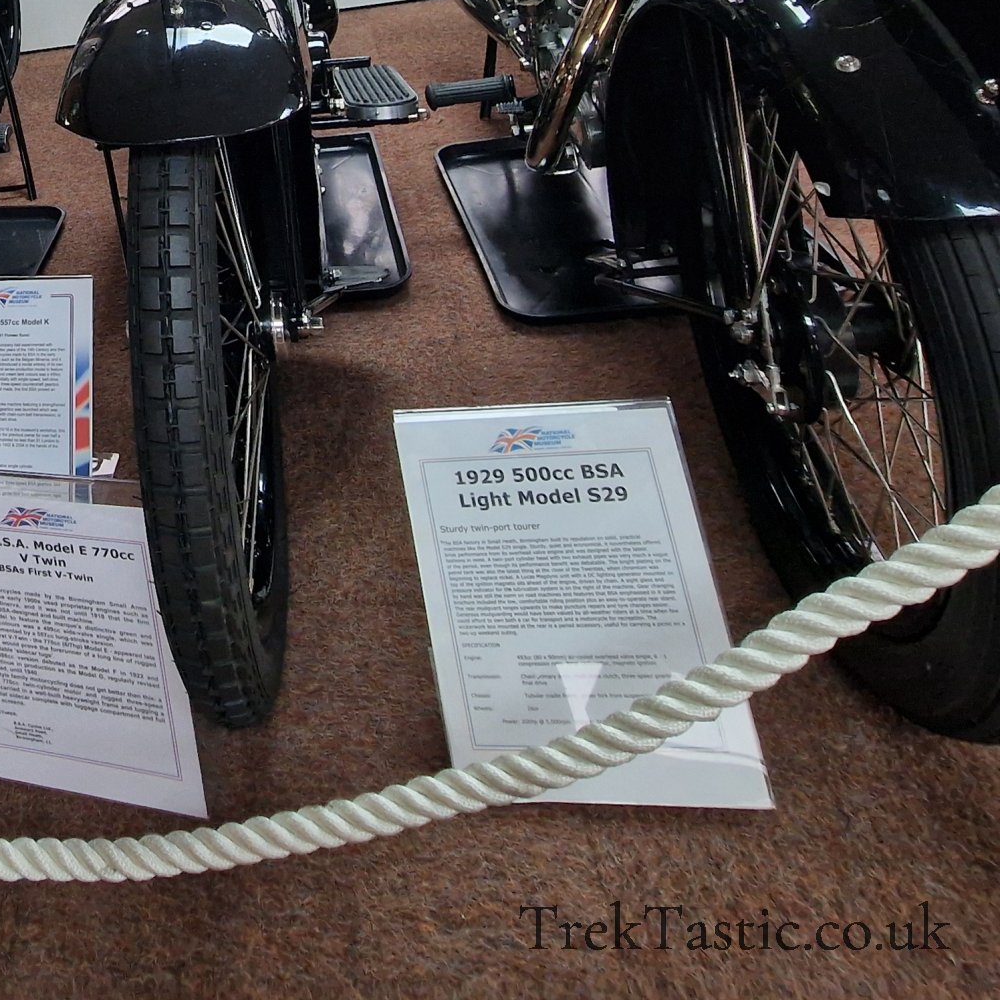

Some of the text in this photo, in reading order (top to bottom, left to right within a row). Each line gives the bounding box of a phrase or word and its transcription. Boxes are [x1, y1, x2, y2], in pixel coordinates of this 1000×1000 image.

[21, 318, 42, 326] Model
[454, 463, 624, 486] 1929 500cc BSA
[458, 485, 629, 511] Light Model S29
[42, 517, 77, 525] MOTORCYCLE
[439, 521, 540, 535] Sturdy twin-port tourer
[33, 540, 74, 554] Model
[78, 545, 87, 555] E
[91, 546, 135, 560] 770cc
[19, 553, 66, 567] V Twin
[27, 567, 52, 577] First
[55, 570, 94, 583] V-Twin
